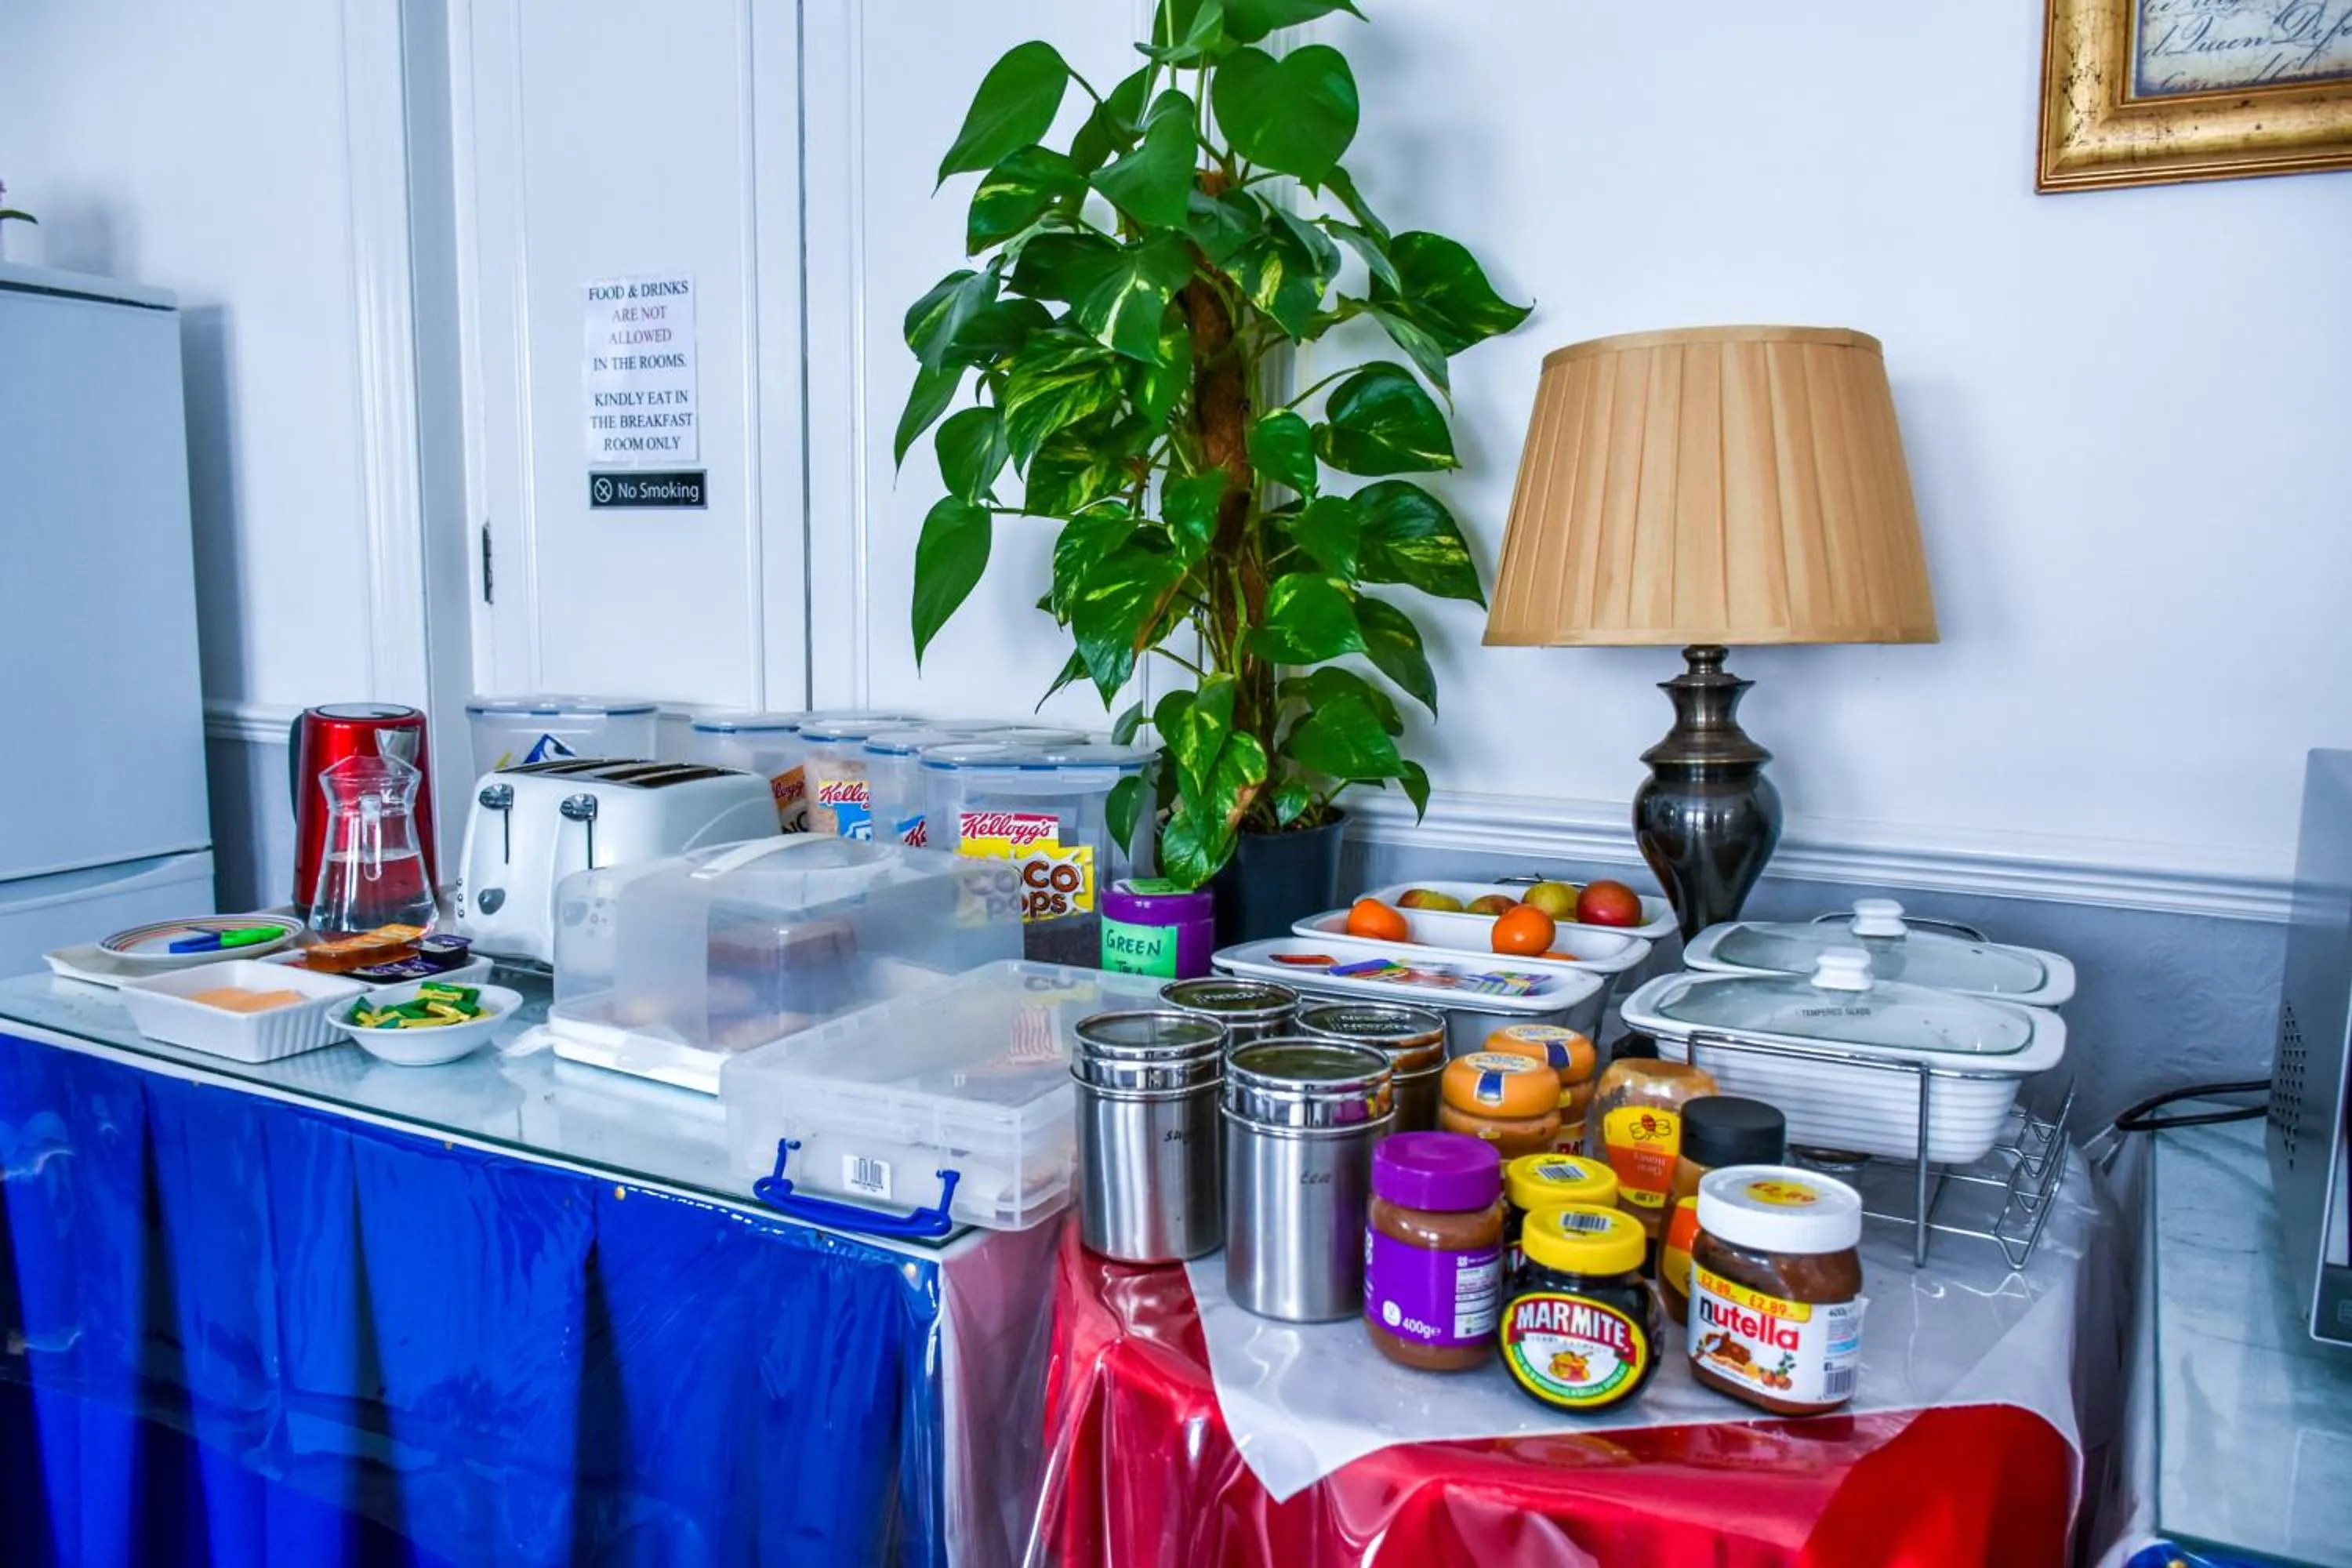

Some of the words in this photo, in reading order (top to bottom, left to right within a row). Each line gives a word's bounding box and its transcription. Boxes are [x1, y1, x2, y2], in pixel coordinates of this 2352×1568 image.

[589, 285, 625, 300] FOOD
[628, 284, 638, 299] &
[641, 281, 689, 298] DRINKS
[612, 307, 638, 323] ARE
[641, 305, 667, 320] NOT
[608, 328, 672, 345] ALLOWED
[593, 357, 608, 371] IN
[611, 355, 637, 370] THE
[594, 392, 643, 407] KINDLY
[648, 390, 671, 405] EAT
[675, 390, 688, 404] IN
[590, 415, 617, 429] THE
[620, 412, 693, 429] BREAKFAST
[604, 437, 644, 452] ROOM
[646, 435, 681, 450] ONLY
[617, 482, 637, 499] No
[639, 481, 699, 503] Smoking
[961, 813, 1051, 845] Kellogg's
[1105, 928, 1162, 956] GREEN
[1515, 1301, 1628, 1349] MARMITE
[1699, 1295, 1799, 1352] nutella
